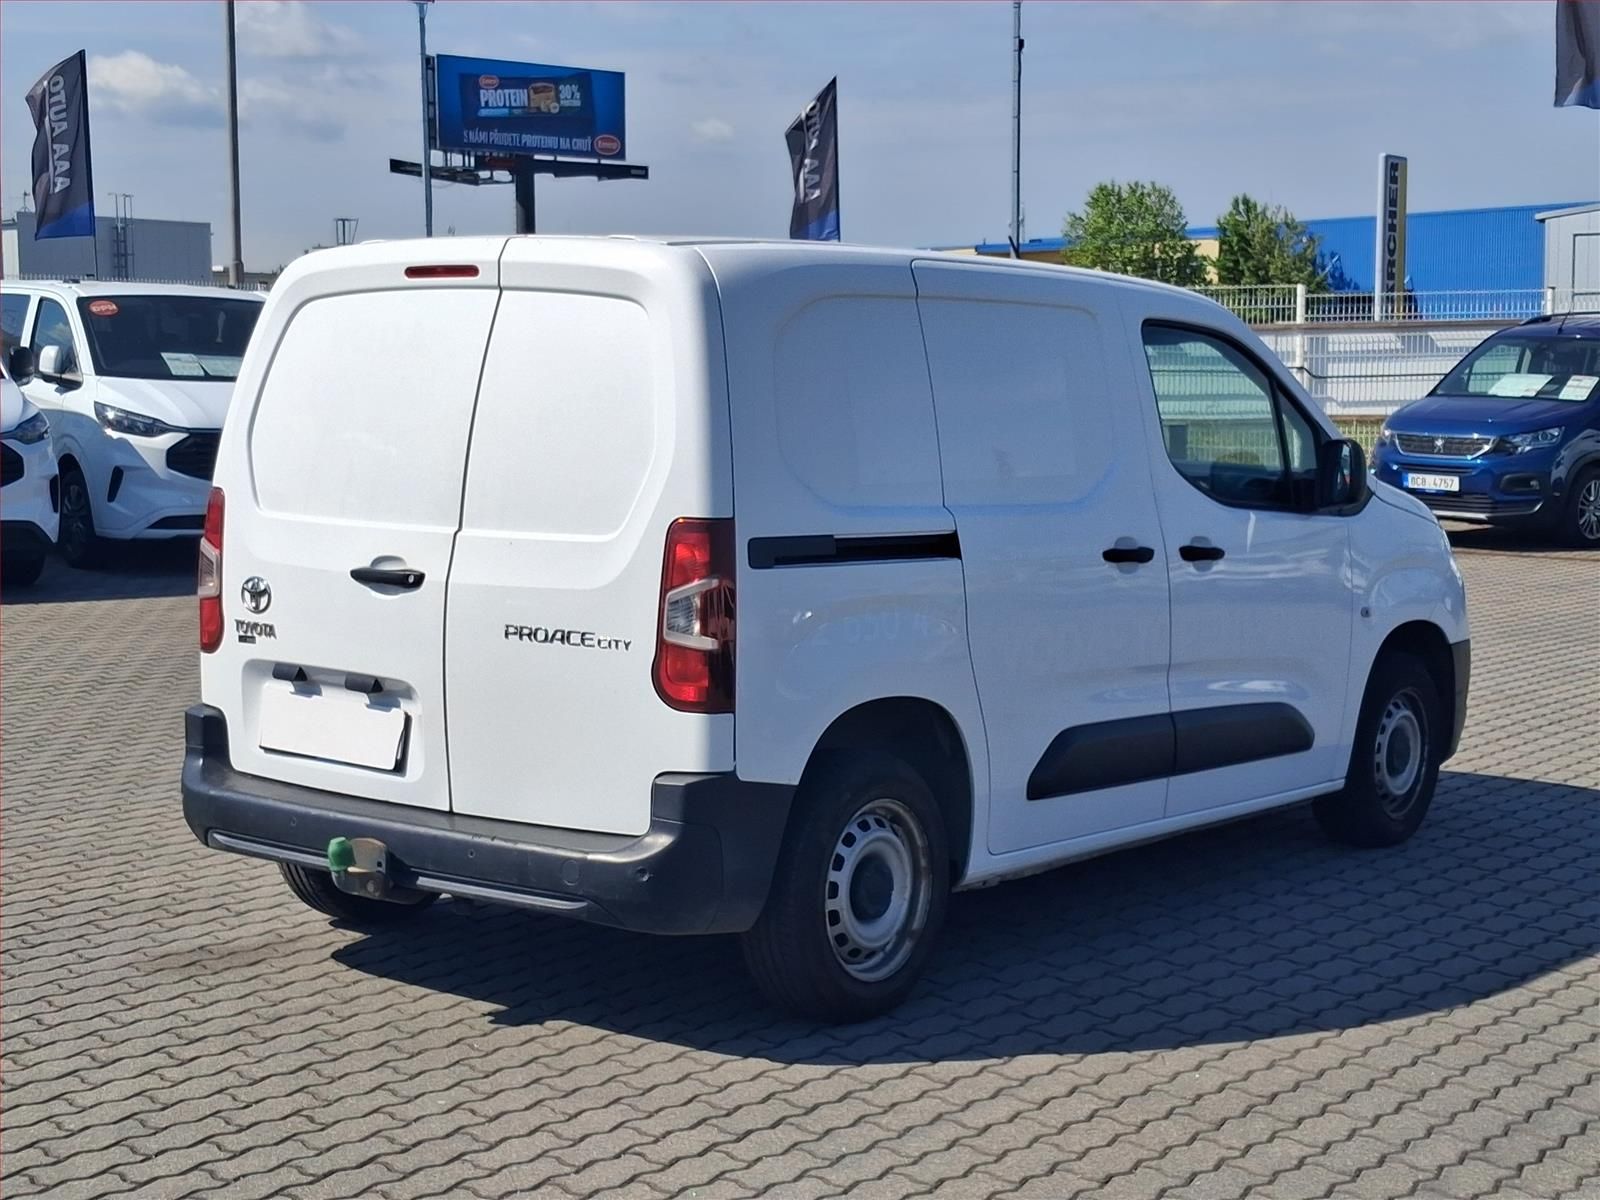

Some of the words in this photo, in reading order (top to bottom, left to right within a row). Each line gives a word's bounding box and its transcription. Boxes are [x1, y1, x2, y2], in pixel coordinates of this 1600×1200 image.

[480, 88, 529, 108] PROTEIN
[469, 127, 489, 144] NÁMI
[234, 619, 278, 640] TOYOTA
[504, 623, 596, 648] PROACE
[597, 637, 632, 651] CITY
